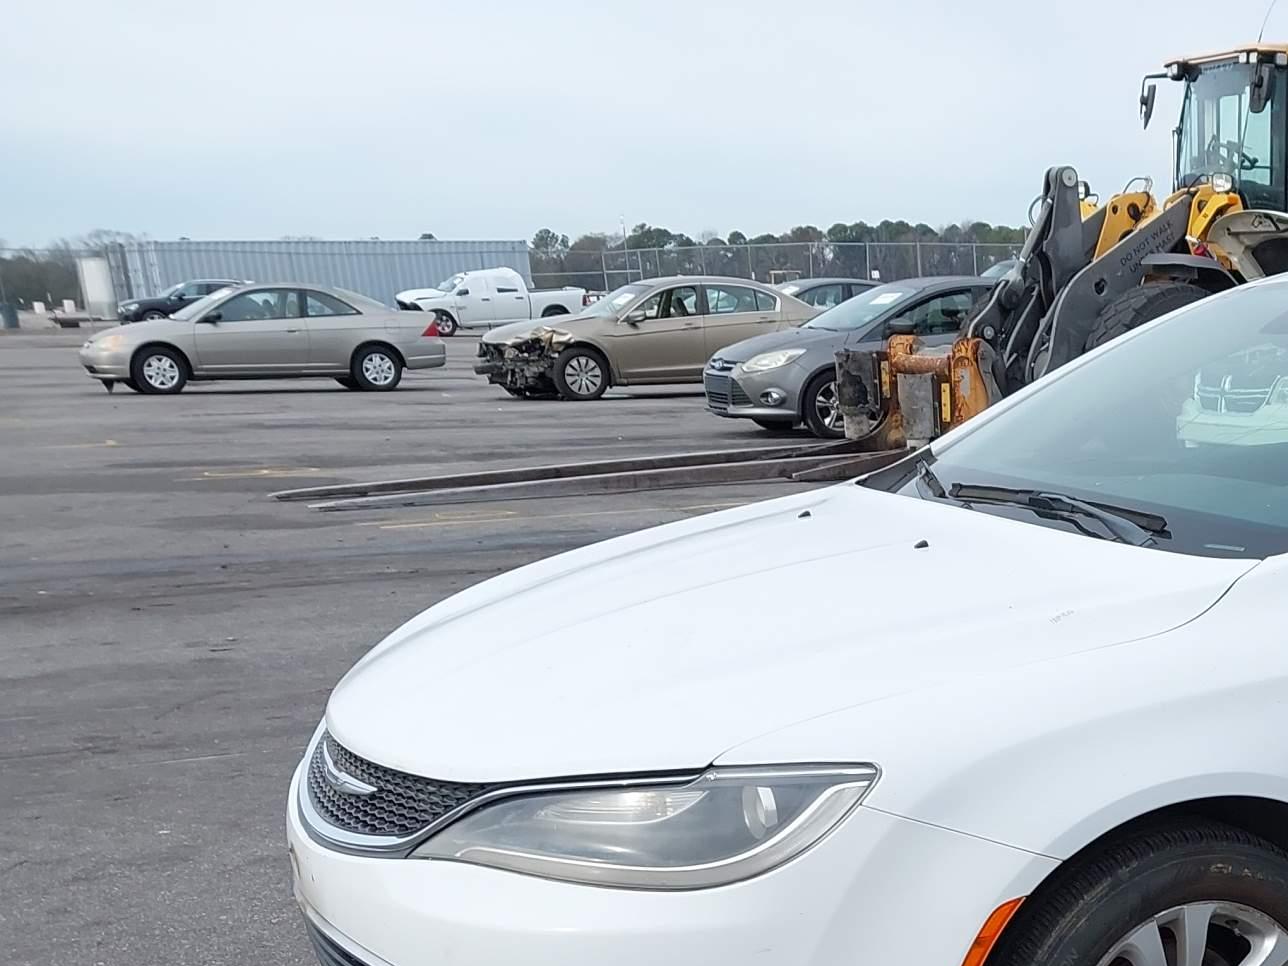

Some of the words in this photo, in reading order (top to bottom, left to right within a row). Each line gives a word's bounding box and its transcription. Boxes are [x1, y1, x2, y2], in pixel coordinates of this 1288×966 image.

[1120, 252, 1133, 266] DO
[1133, 236, 1151, 256] NOT
[1151, 220, 1174, 241] WALK
